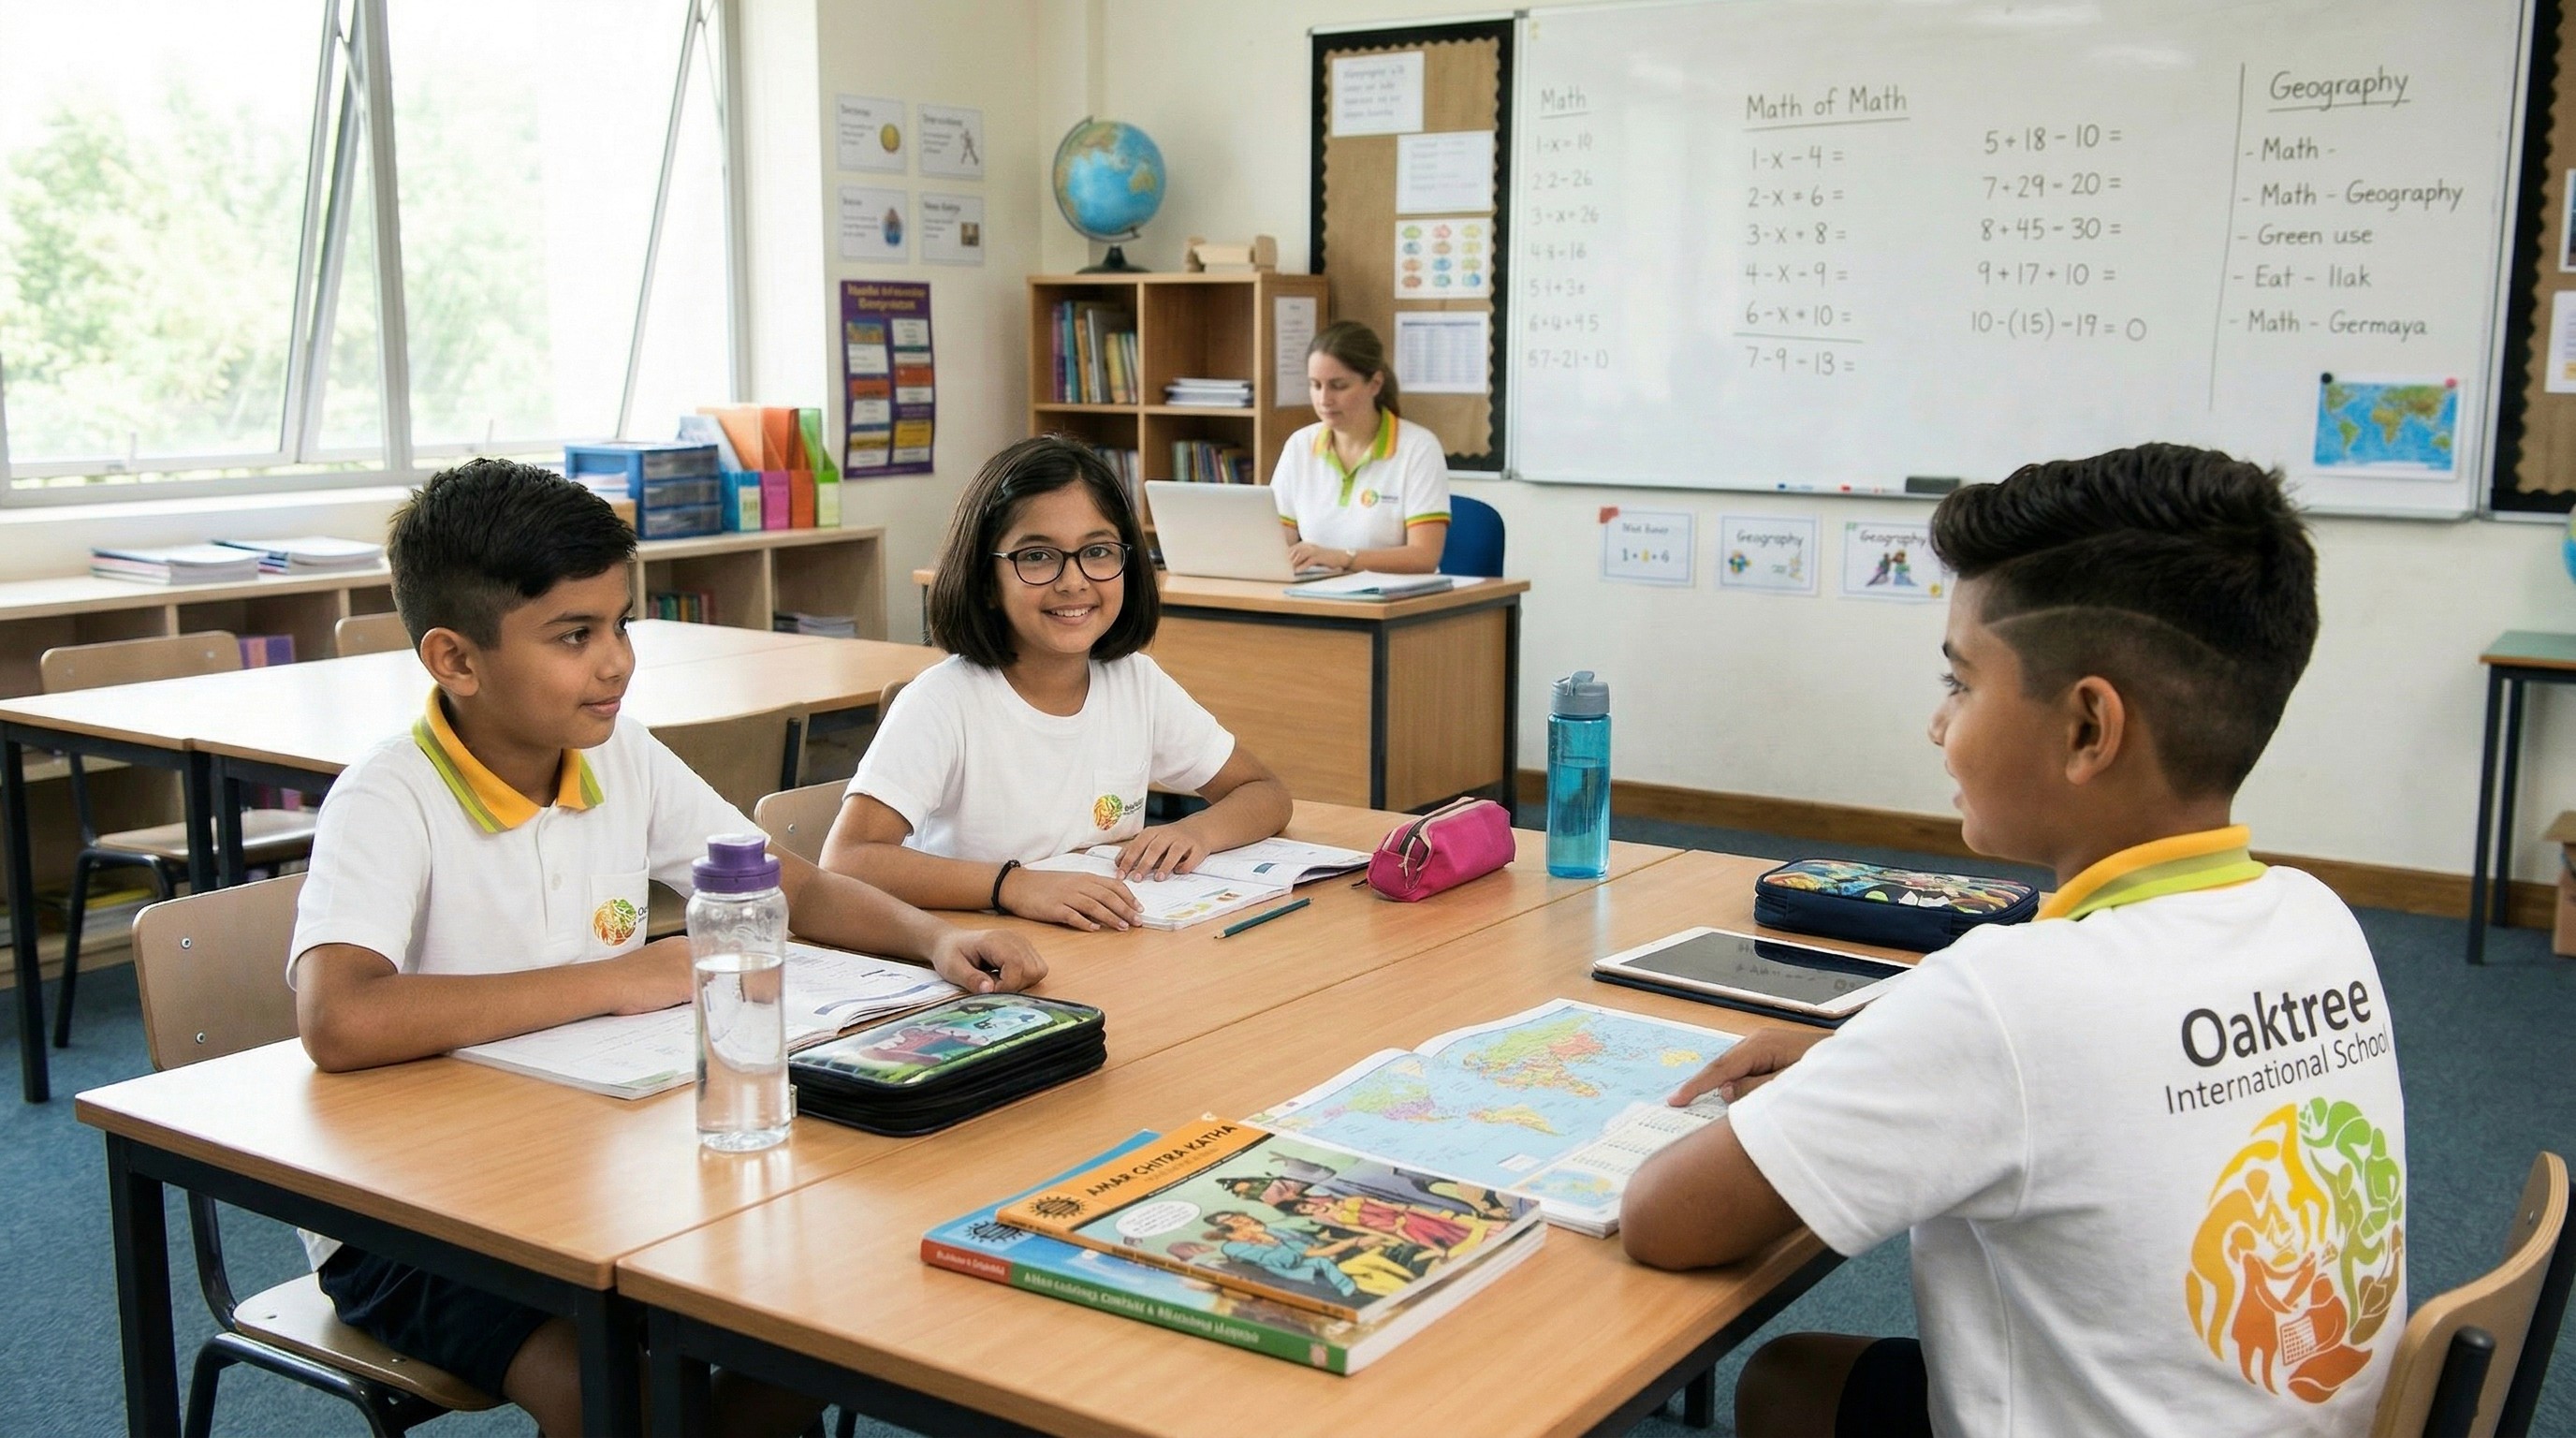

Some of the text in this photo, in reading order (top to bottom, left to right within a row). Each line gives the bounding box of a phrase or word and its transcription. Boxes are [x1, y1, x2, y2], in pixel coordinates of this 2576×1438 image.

[1541, 85, 1587, 111] Math
[2270, 65, 2409, 111] Geography
[1746, 83, 1908, 121] Math of Math
[1984, 130, 1998, 154] 5
[2026, 126, 2046, 152] 18
[2075, 124, 2100, 149] 10
[2109, 129, 2122, 141] =
[2261, 137, 2319, 161] Math
[1808, 144, 1822, 169] 4
[1810, 183, 1824, 207] 6
[1983, 176, 1998, 199] 7
[2017, 174, 2045, 198] 29
[2071, 172, 2101, 196] 20
[2109, 177, 2121, 188] =
[2260, 183, 2317, 207] Math
[2346, 178, 2464, 213] Geography
[1814, 221, 1828, 244] 8
[1981, 218, 1995, 242] 8
[2016, 217, 2045, 241] 45
[2071, 216, 2101, 241] 30
[2109, 224, 2121, 234] =
[2258, 224, 2323, 246] Green
[2334, 228, 2373, 244] use
[1813, 260, 1826, 287] 9
[1835, 270, 1848, 281] =
[1977, 260, 1991, 285] 9
[2018, 262, 2040, 286] 17
[2067, 262, 2090, 286] 10
[2103, 269, 2115, 280] =
[2255, 264, 2293, 288] Eat
[1814, 304, 1834, 327] 10
[2247, 308, 2300, 333] Math
[2329, 308, 2427, 343] Germaya
[1815, 351, 1836, 375] 13
[1737, 529, 1804, 549] Geography
[1860, 529, 1926, 549] Geography
[2181, 980, 2372, 1067] Oaktree
[2165, 1023, 2391, 1114] International School
[1086, 1173, 1132, 1196] AMAR
[1132, 1149, 1190, 1175] CHITRA
[1184, 1124, 1238, 1151] KATHA
